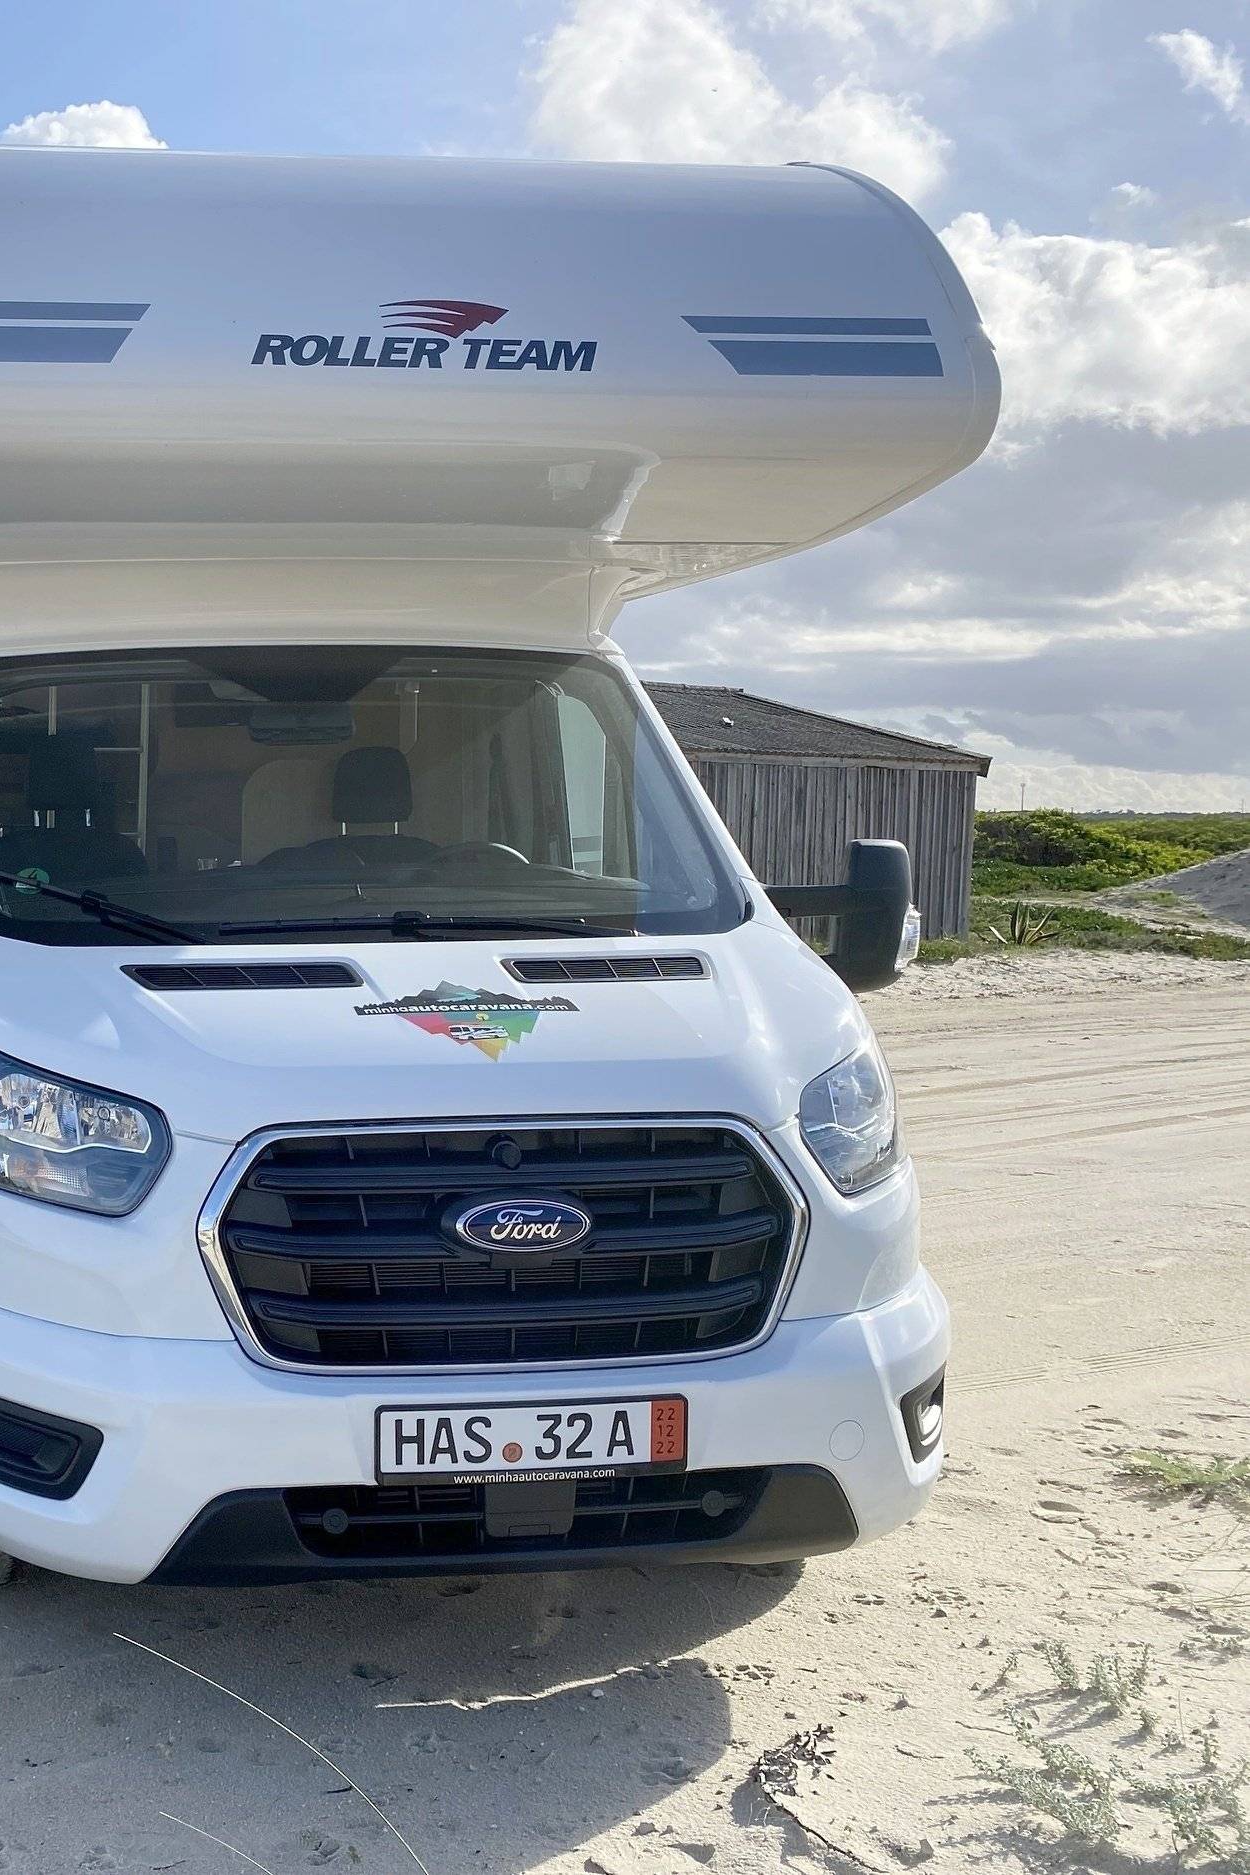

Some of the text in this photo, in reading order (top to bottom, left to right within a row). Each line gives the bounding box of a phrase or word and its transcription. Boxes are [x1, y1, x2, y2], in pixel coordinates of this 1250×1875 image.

[250, 334, 598, 372] ROLLER TEAM
[490, 1208, 562, 1240] Ford
[656, 1407, 675, 1421] 22
[394, 1410, 635, 1466] HAS 32 A
[658, 1424, 674, 1437] 12
[656, 1440, 675, 1454] 22
[453, 1468, 615, 1484] www.minhaautocaravana.com
